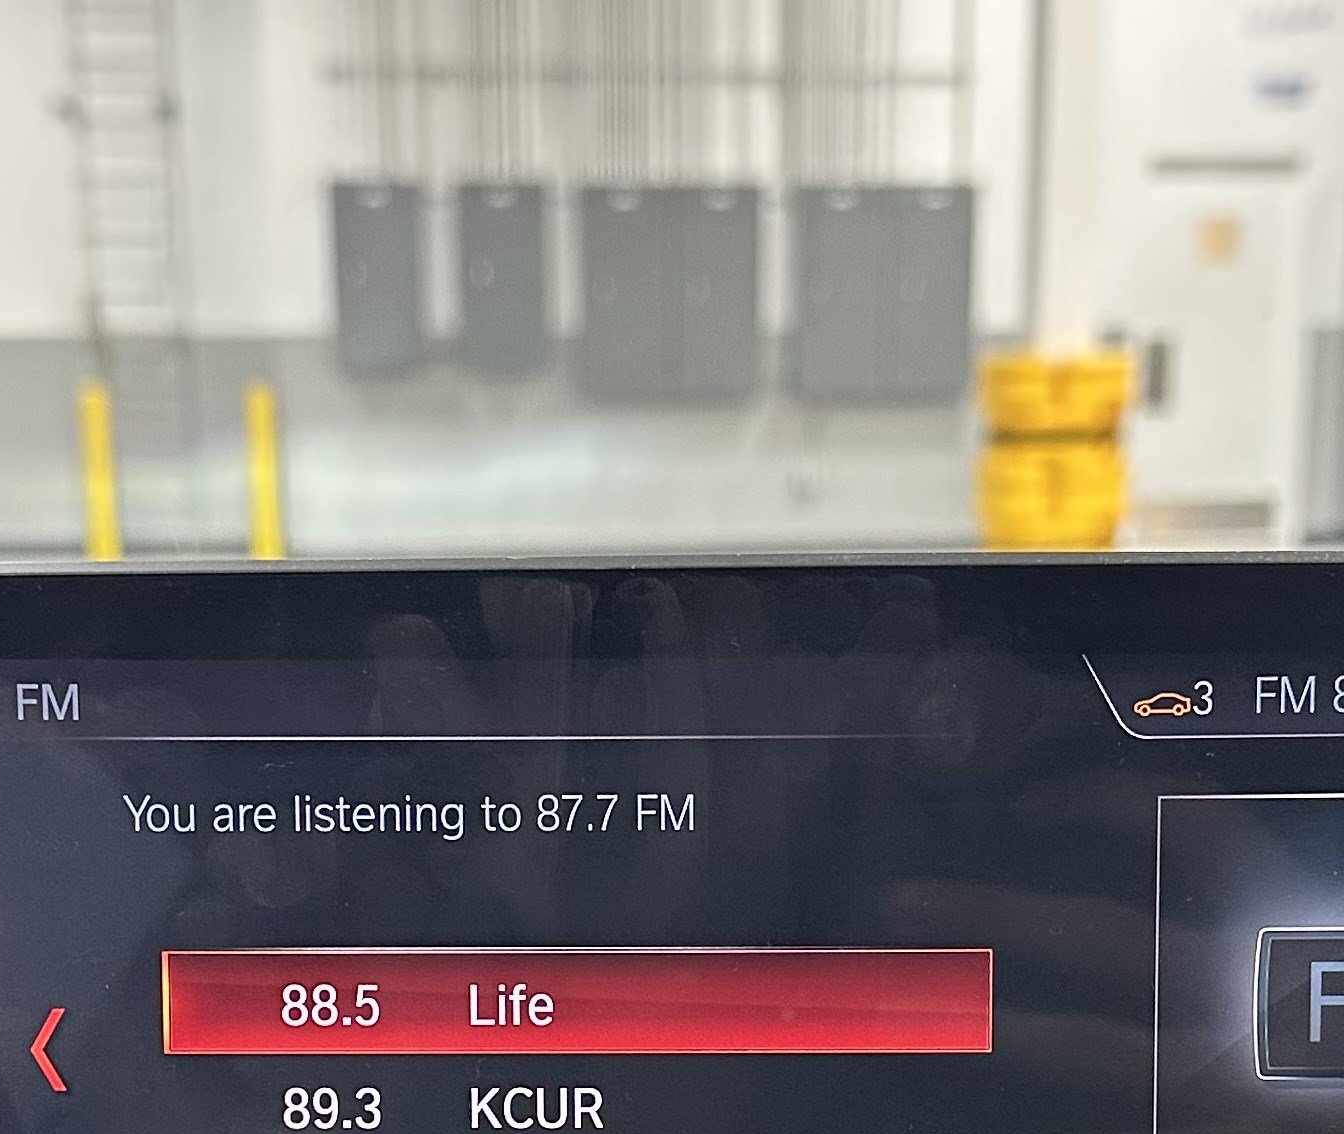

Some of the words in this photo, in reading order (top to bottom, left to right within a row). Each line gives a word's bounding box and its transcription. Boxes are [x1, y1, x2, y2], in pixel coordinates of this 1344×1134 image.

[16, 683, 80, 721] FM
[1192, 680, 1213, 716] 3
[1255, 675, 1316, 714] FM
[122, 794, 196, 833] You
[213, 803, 277, 833] are
[294, 794, 464, 841] listening
[480, 796, 522, 832] to
[537, 794, 618, 832] 87.7
[637, 793, 695, 831] FM
[281, 983, 380, 1027] 88.5
[469, 983, 554, 1026] Life
[283, 1087, 381, 1130] 89.3
[470, 1086, 604, 1130] KCUR
